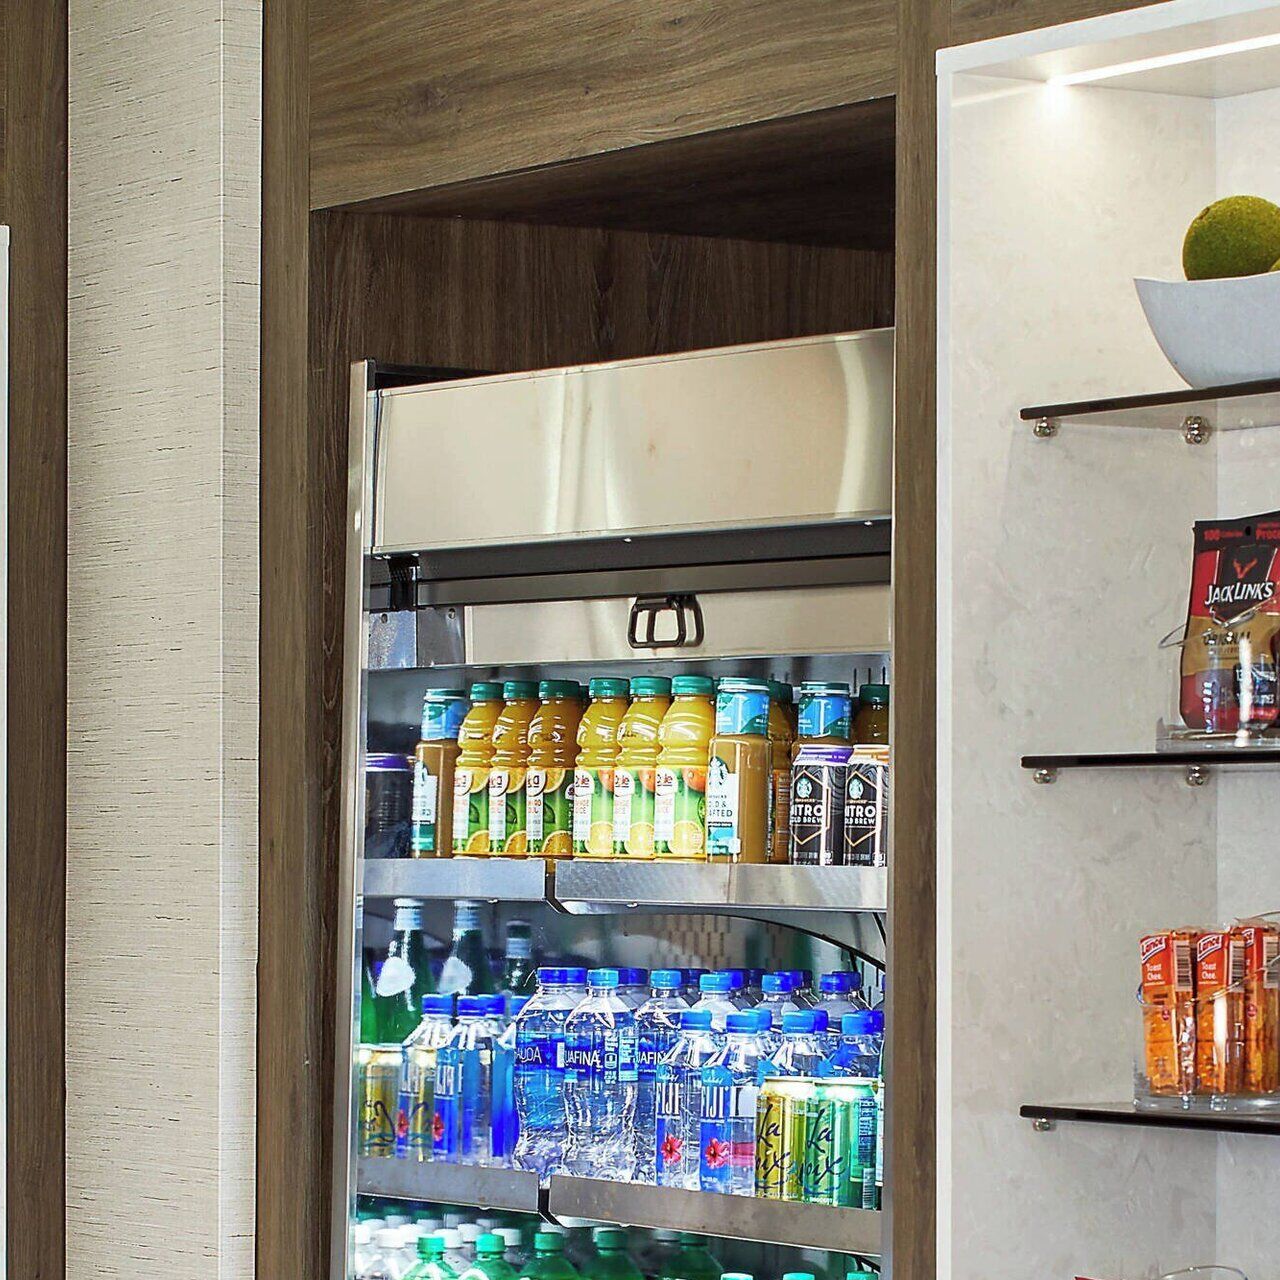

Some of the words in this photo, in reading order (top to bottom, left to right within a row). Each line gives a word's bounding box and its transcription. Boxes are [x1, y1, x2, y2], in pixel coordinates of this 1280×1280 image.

[1205, 584, 1234, 605] JACK
[1146, 963, 1162, 972] Toast
[1201, 962, 1217, 971] Toast
[701, 1086, 725, 1119] FIJI
